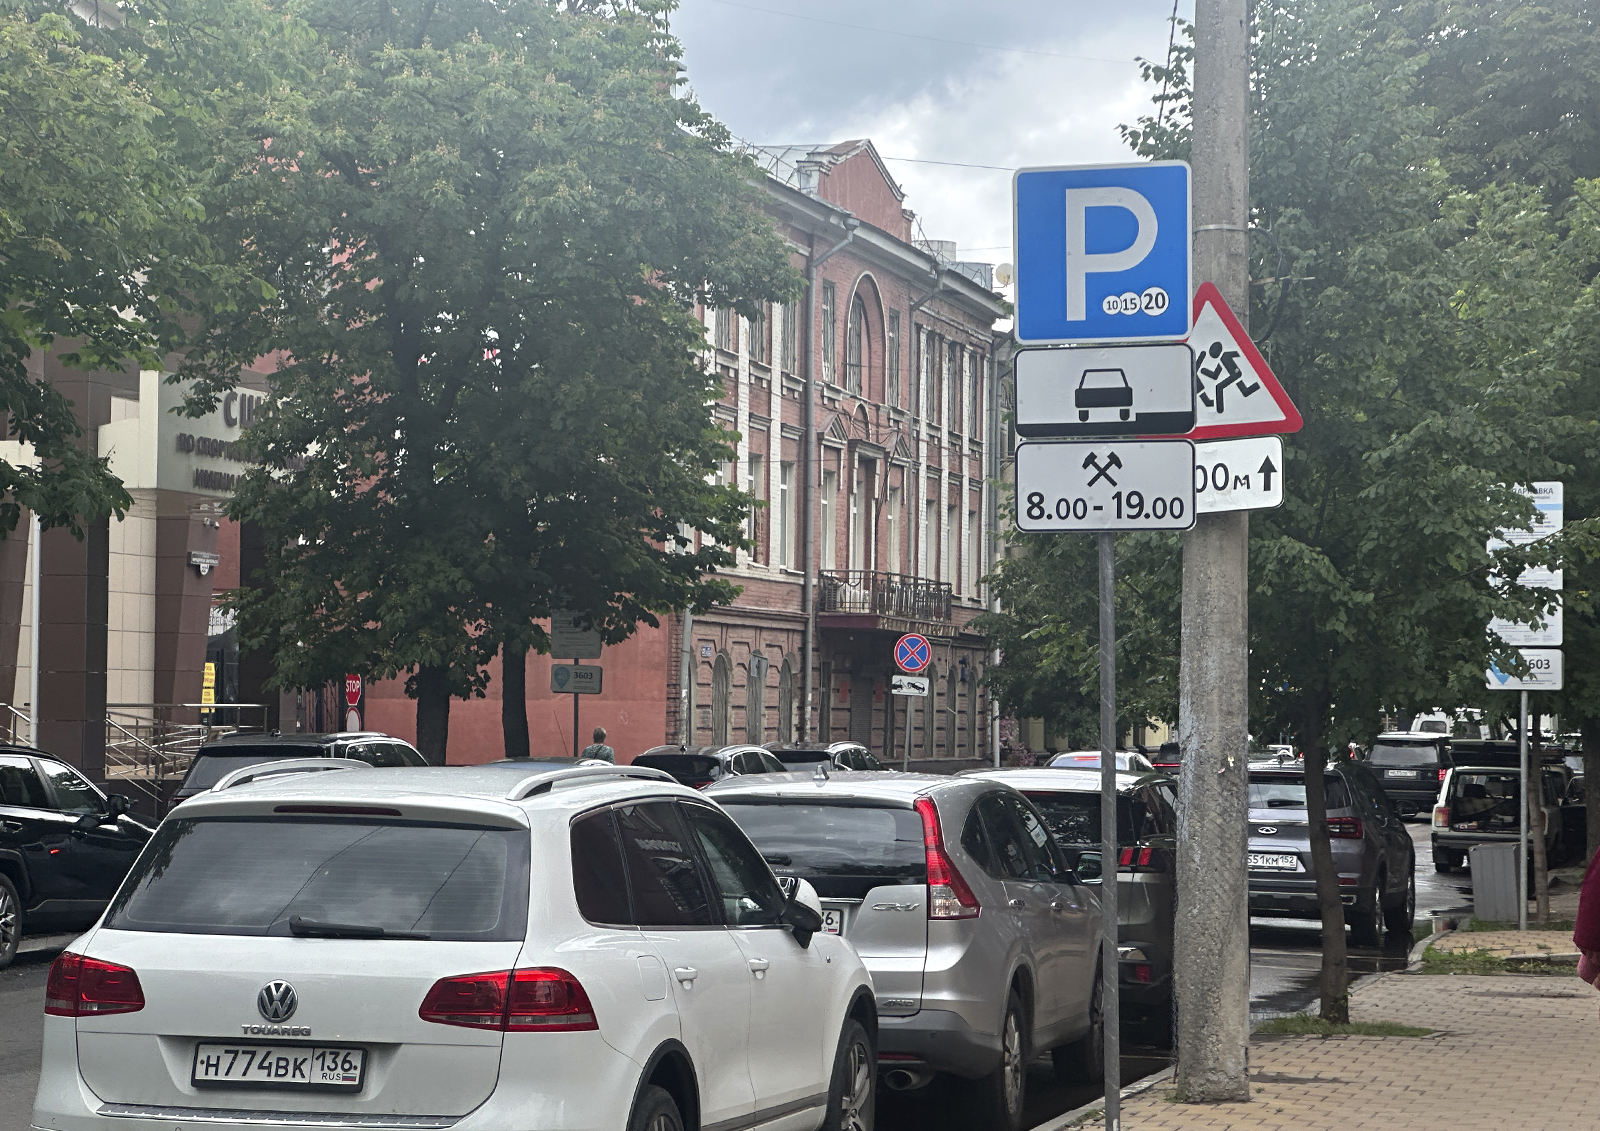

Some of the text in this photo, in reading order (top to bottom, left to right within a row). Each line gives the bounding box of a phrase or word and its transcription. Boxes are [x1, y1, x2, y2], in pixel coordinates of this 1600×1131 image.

[1065, 186, 1158, 321] P
[1106, 292, 1166, 311] 10 15 20
[1526, 659, 1551, 670] 603
[573, 671, 593, 680] 3603
[346, 680, 360, 693] STOP
[1280, 855, 1294, 864] 152
[241, 1024, 311, 1036] TOUAREG
[205, 1050, 354, 1079] Н774ВК 136
[321, 1072, 341, 1081] RUS
